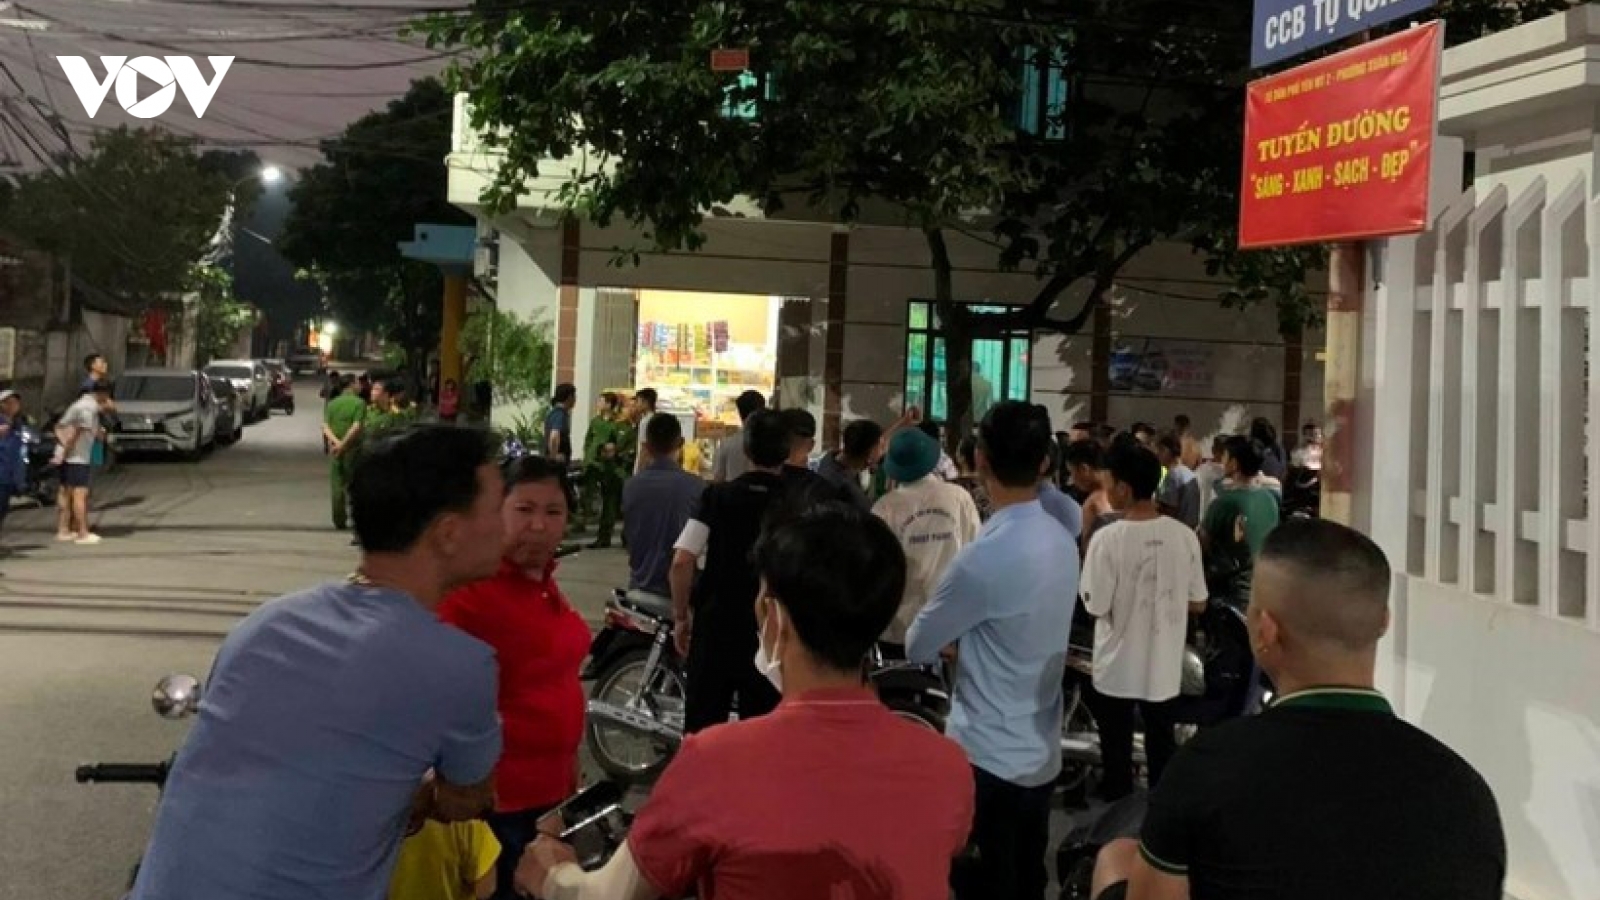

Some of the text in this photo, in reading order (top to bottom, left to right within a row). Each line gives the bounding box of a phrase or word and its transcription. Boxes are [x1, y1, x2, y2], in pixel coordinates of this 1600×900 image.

[1265, 5, 1306, 49] CCB
[1326, 105, 1411, 147] ĐƯỜNG
[1292, 165, 1324, 193] XANH
[1333, 156, 1370, 190] SẠCH
